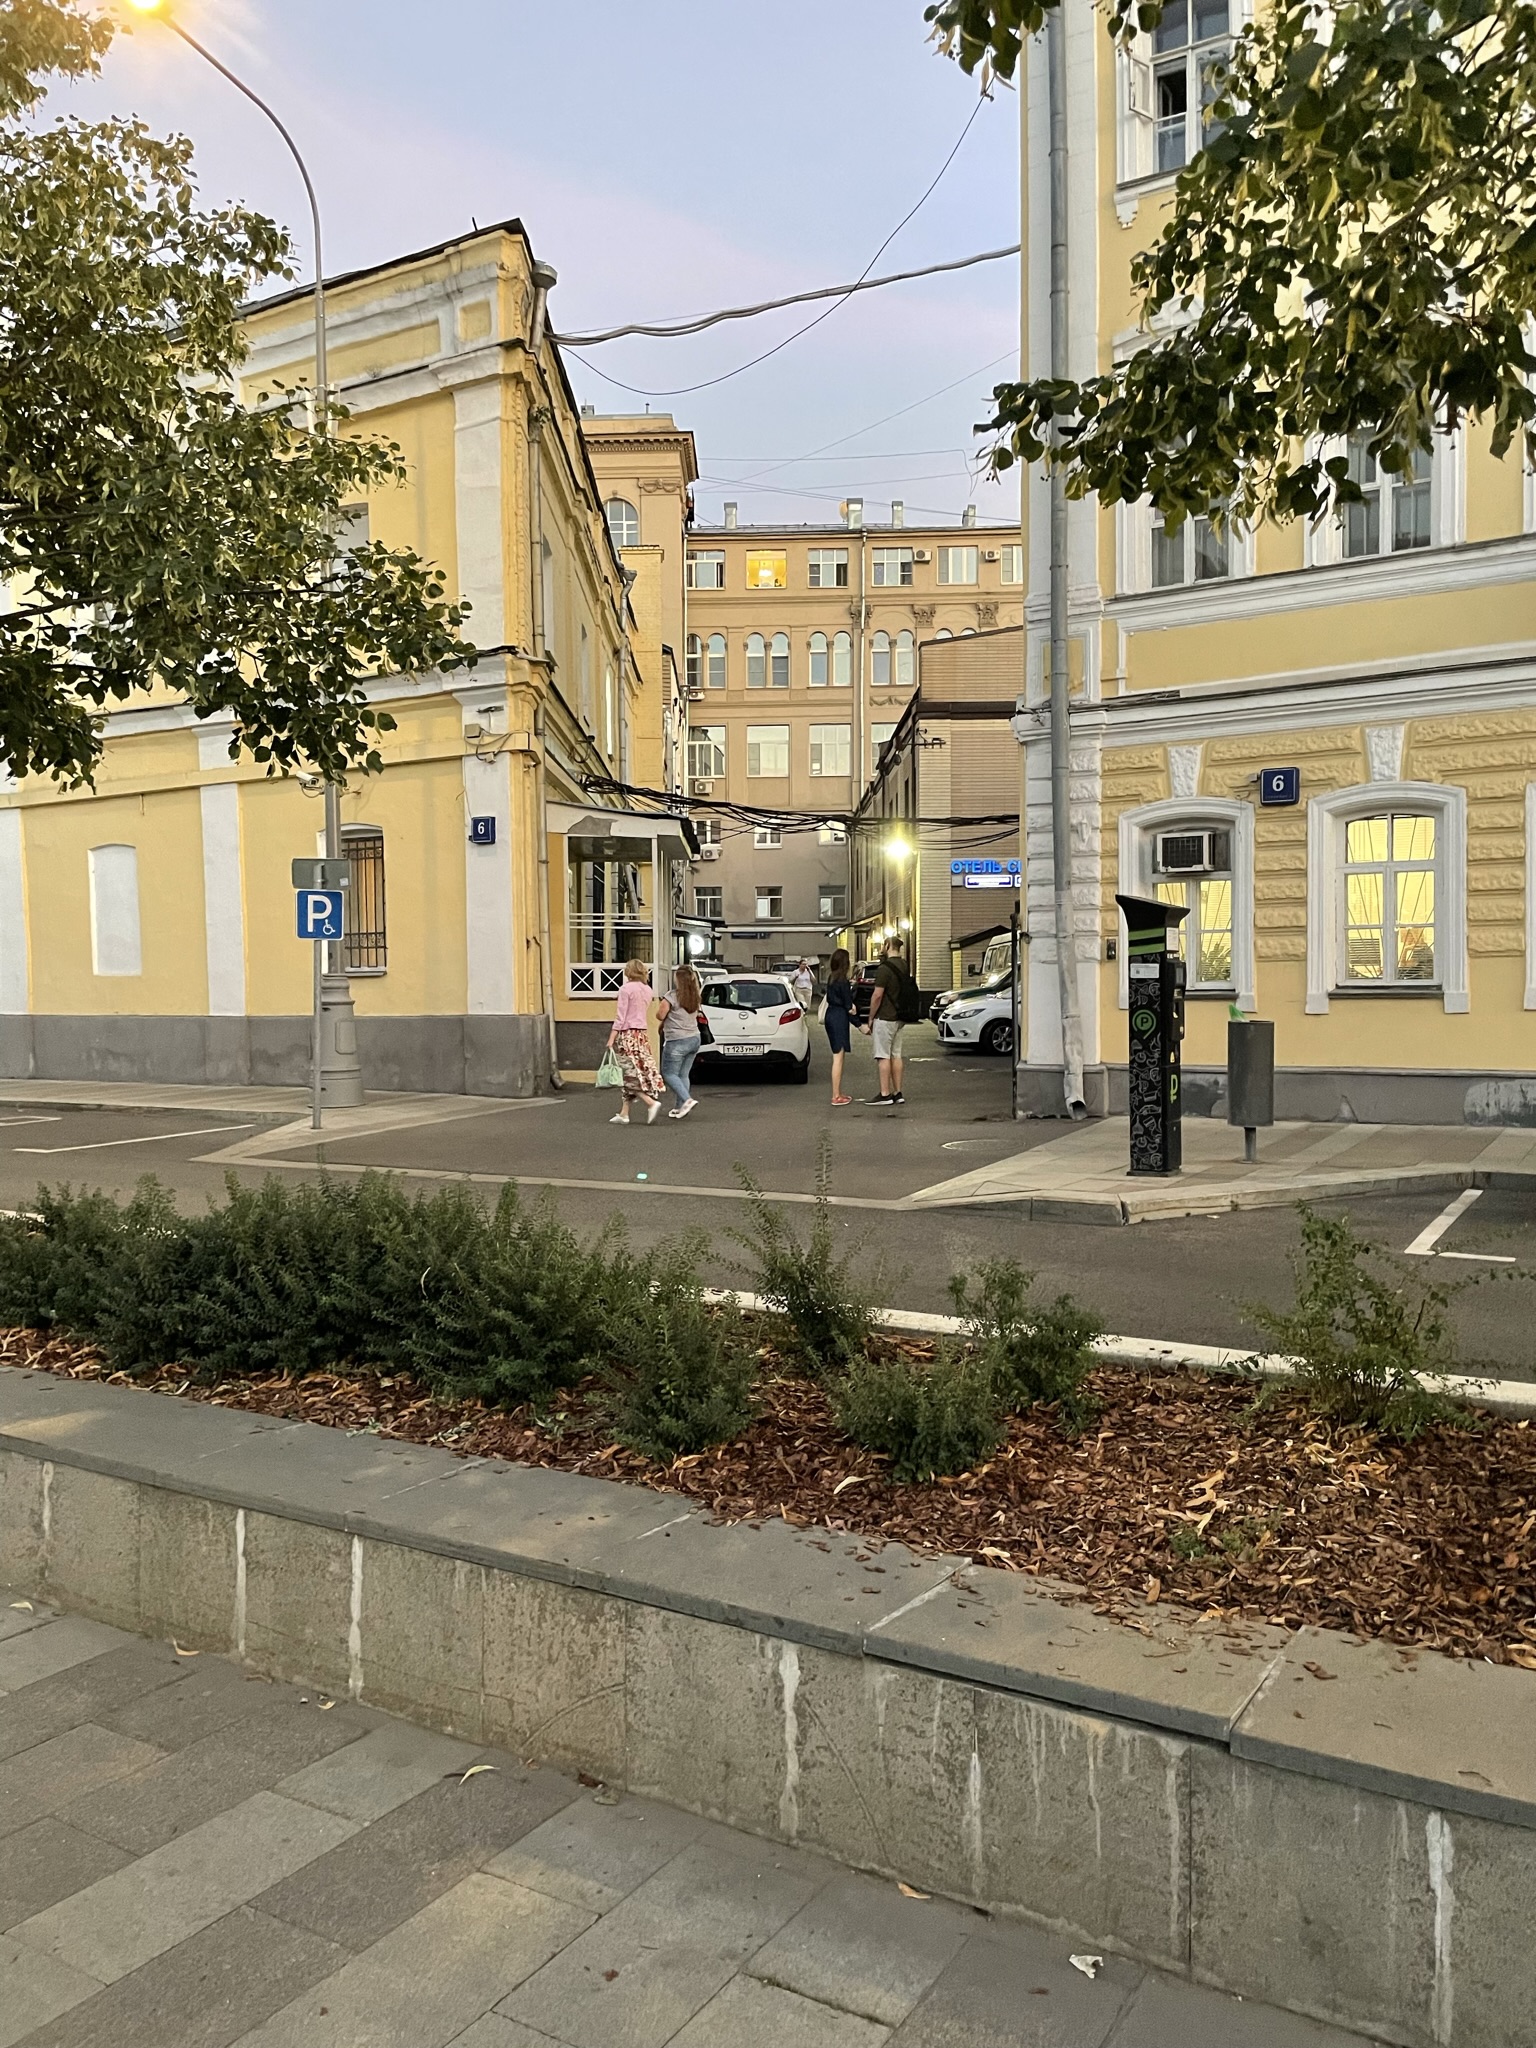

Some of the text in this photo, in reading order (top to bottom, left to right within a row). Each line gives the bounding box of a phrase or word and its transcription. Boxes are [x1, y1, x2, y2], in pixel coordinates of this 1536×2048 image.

[1272, 775, 1284, 792] 6
[477, 821, 485, 835] 6
[951, 860, 1003, 873] ОТЕЛЬ
[307, 895, 332, 933] P
